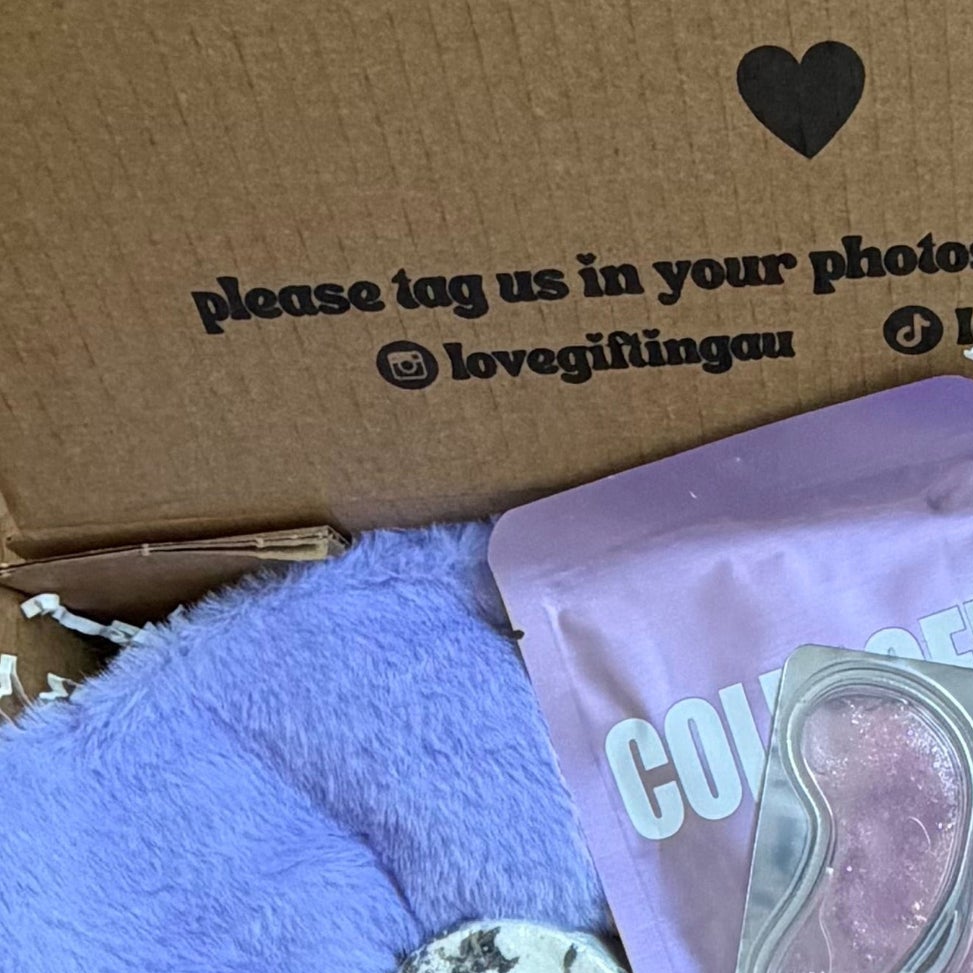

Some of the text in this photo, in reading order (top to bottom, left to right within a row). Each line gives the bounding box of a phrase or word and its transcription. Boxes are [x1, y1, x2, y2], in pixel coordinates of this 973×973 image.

[191, 275, 385, 334] please
[392, 268, 489, 320] tag
[496, 268, 570, 304] us
[576, 253, 645, 298] in
[652, 252, 798, 306] your
[443, 328, 796, 384] lovegiftingau
